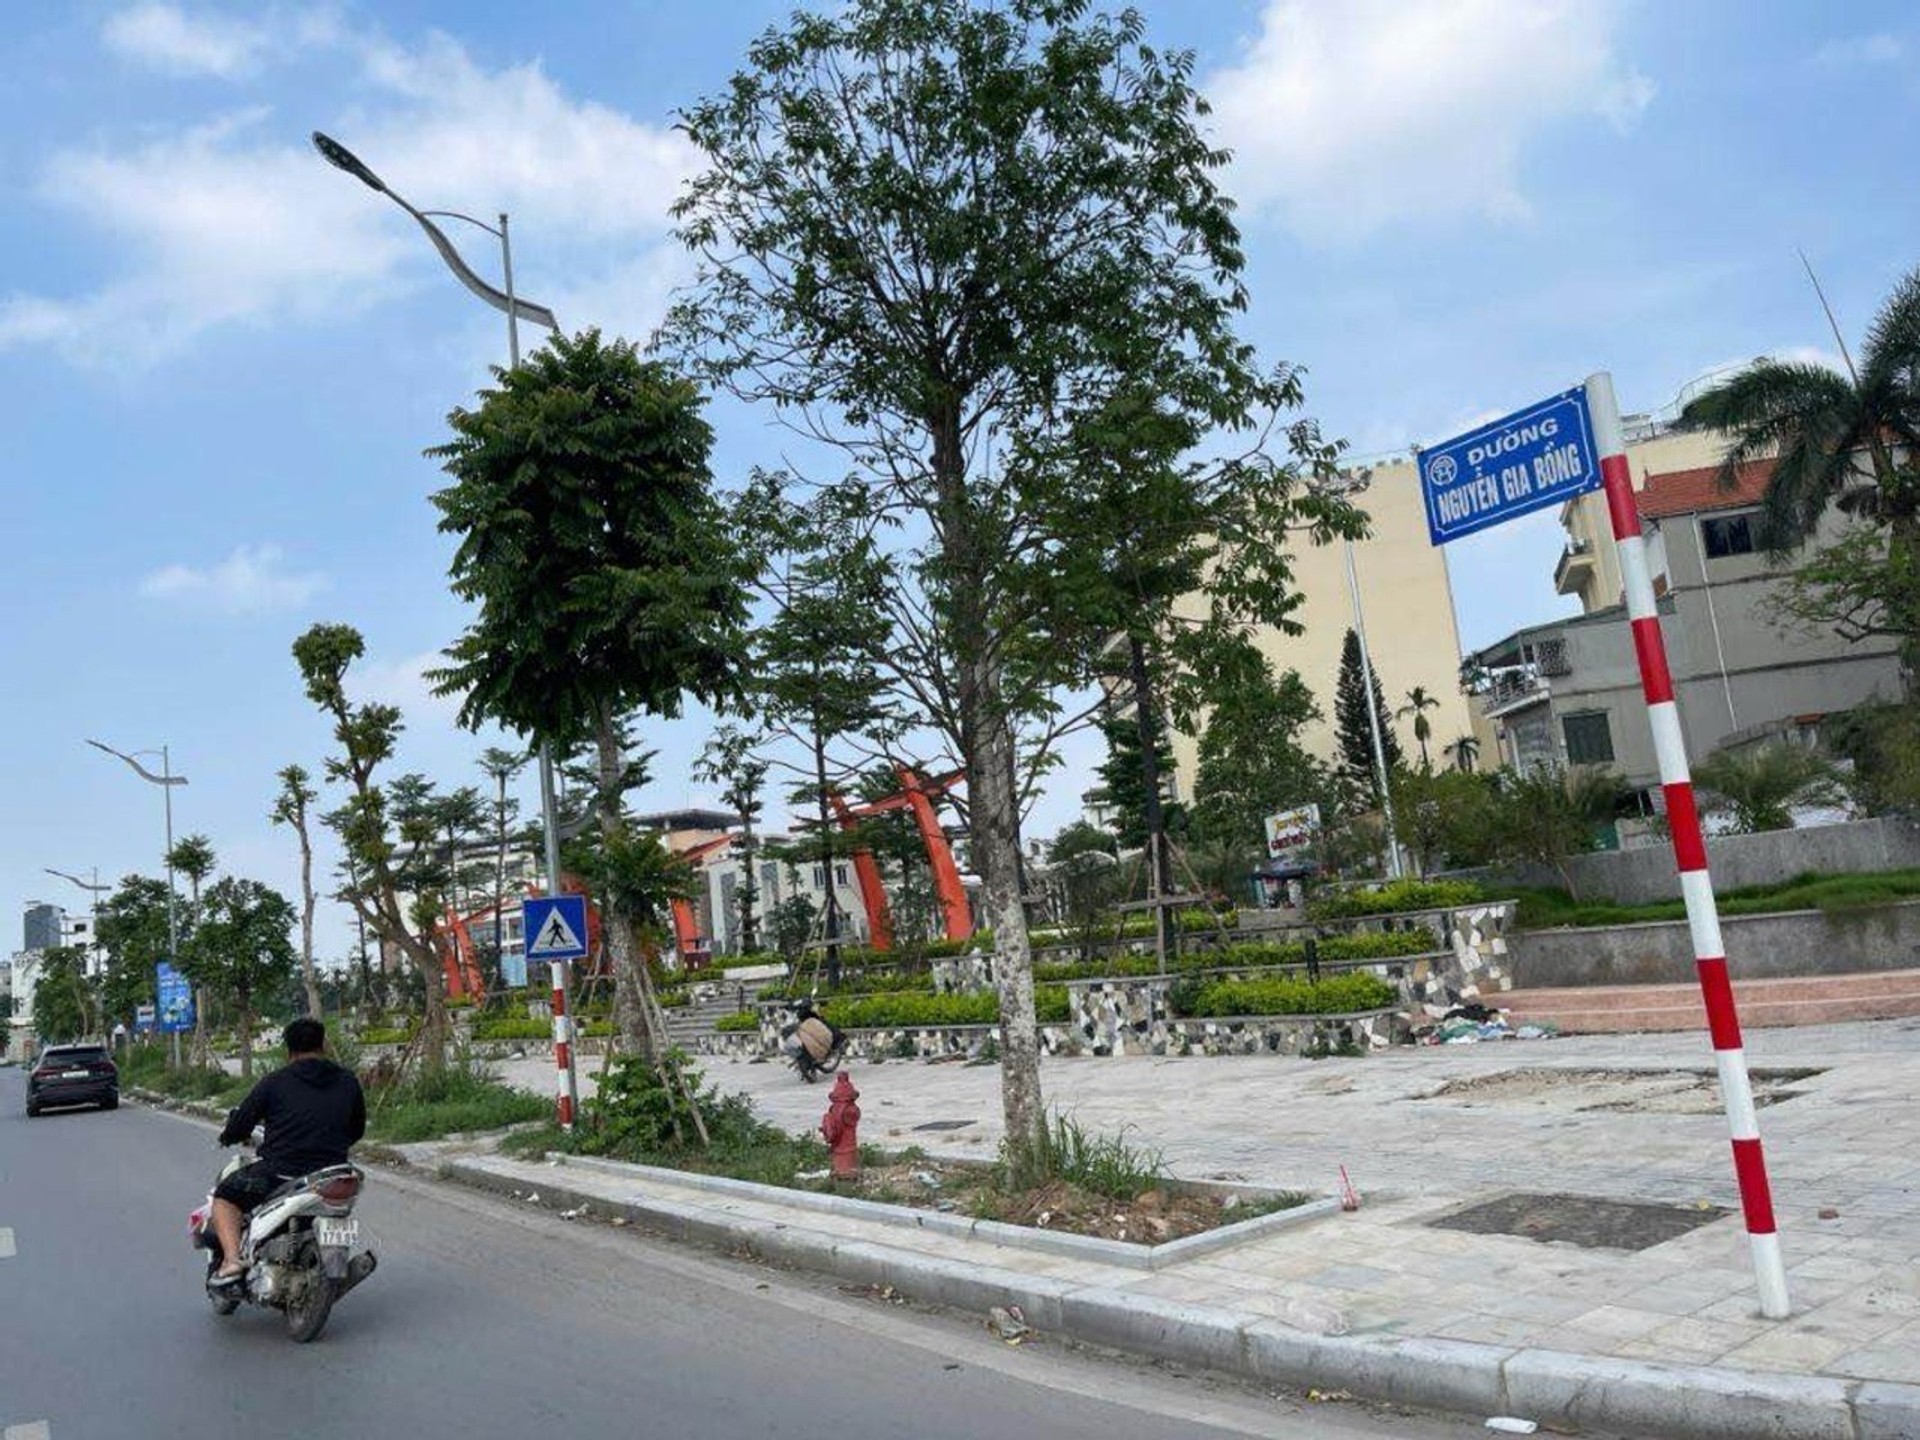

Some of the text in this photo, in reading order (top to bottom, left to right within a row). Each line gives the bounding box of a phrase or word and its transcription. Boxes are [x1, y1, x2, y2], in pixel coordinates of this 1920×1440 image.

[1467, 418, 1558, 466] ĐƯỜNG
[1438, 441, 1582, 525] NGUYỄN GIA BỒNG
